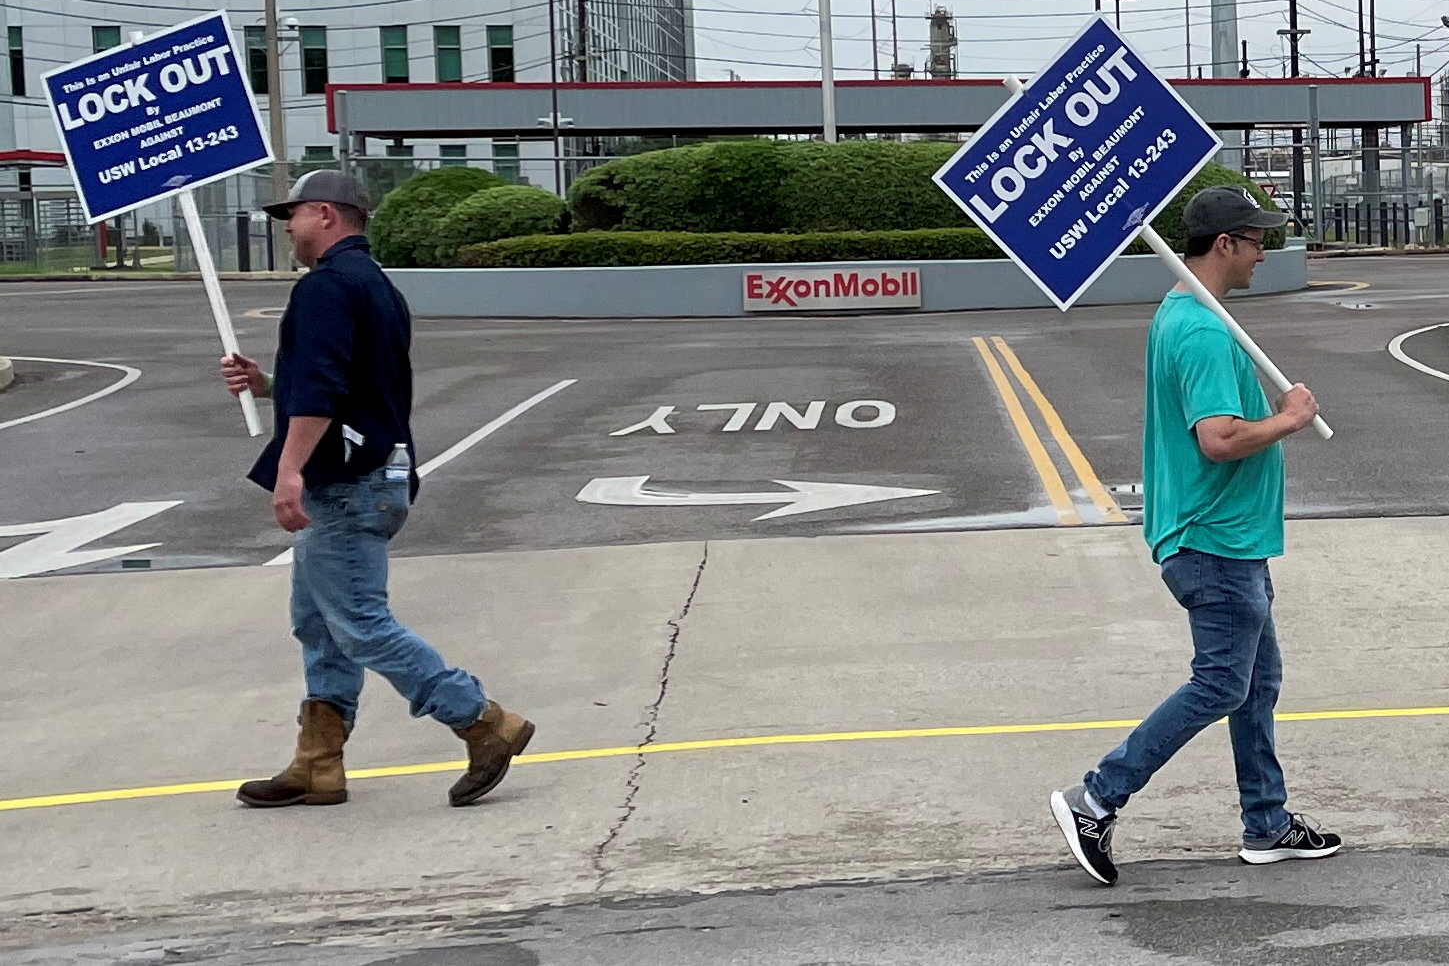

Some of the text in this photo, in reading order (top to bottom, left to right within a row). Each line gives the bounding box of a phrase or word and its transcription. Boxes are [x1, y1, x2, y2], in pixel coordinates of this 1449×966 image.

[57, 44, 231, 130] LOCK OUT
[62, 81, 84, 93] This
[97, 72, 110, 81] an
[110, 60, 140, 76] Unfair
[142, 50, 170, 65] Labor
[171, 35, 214, 54] Practice
[93, 97, 220, 149] EXXON MOBIL BEAUMONT
[140, 125, 183, 148] AGAINST
[145, 105, 159, 115] By
[964, 161, 988, 183] This
[998, 138, 1013, 152] an
[1009, 108, 1040, 138] Unfair
[1038, 81, 1067, 110] Labor
[1064, 44, 1104, 83] Practice
[968, 45, 1138, 223] LOCK OUT
[98, 125, 238, 183] USW Local 13-243
[1028, 105, 1144, 226] EXXON MOBIL BEAUMONT
[1067, 146, 1084, 162] By
[1078, 155, 1119, 200] AGAINST
[1048, 128, 1176, 259] USW Local 13-243
[746, 272, 918, 307] ExxonMobil
[609, 400, 896, 436] ONLY
